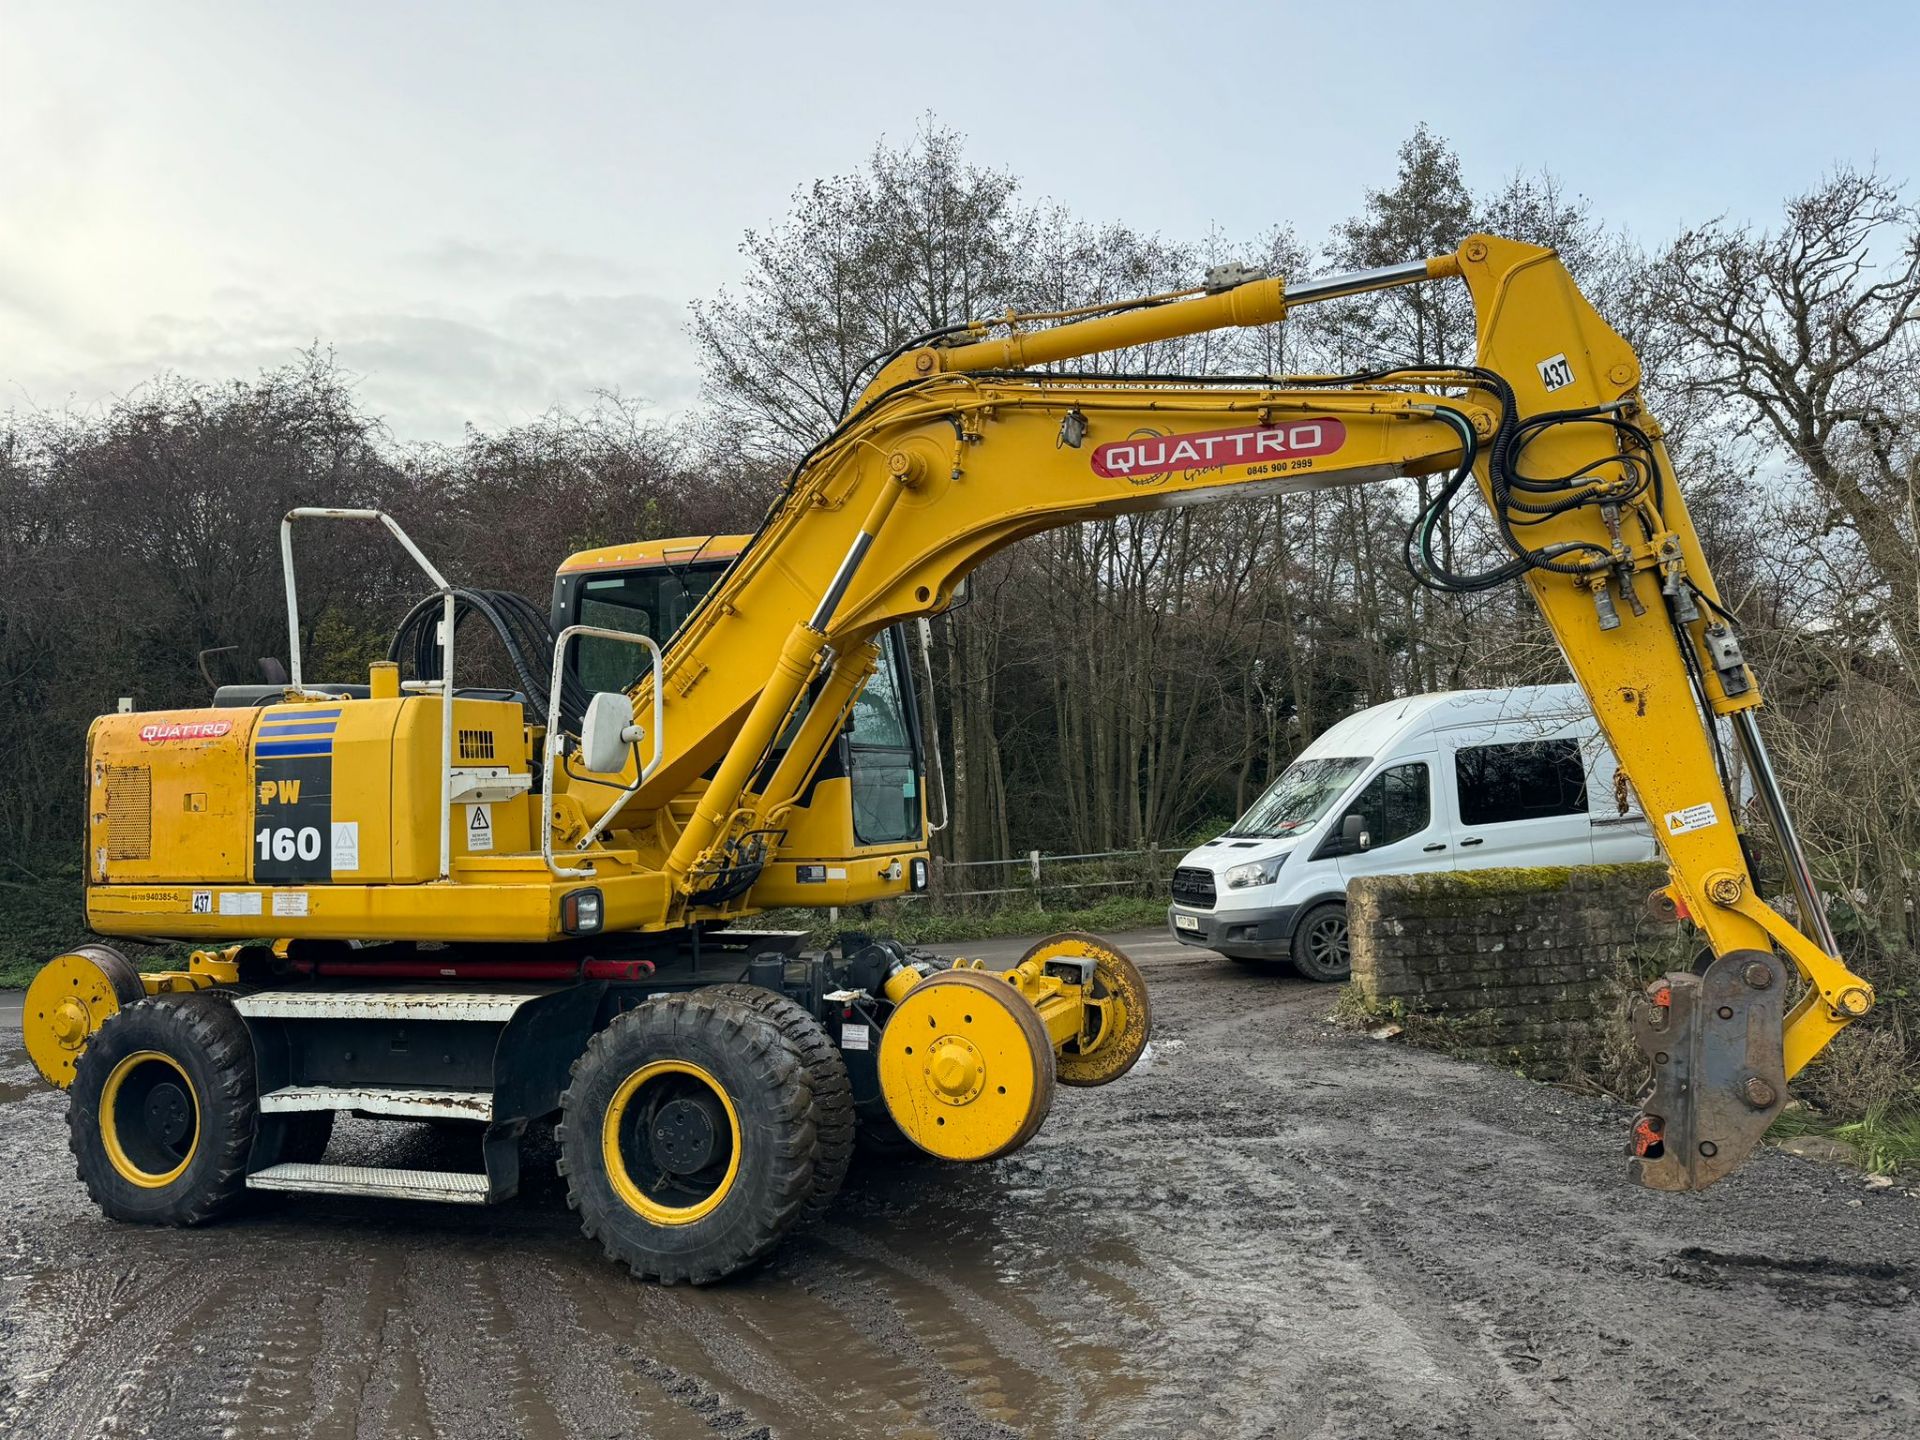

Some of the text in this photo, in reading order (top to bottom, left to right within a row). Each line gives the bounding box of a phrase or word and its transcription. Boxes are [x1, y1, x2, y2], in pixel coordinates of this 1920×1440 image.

[1543, 359, 1571, 389] 437
[1106, 424, 1322, 473] QUATTRO
[1247, 458, 1313, 476] 0845 900 2999
[142, 723, 228, 741] QUATTRO
[260, 779, 301, 806] PW
[256, 826, 322, 862] 160
[194, 894, 209, 913] 437
